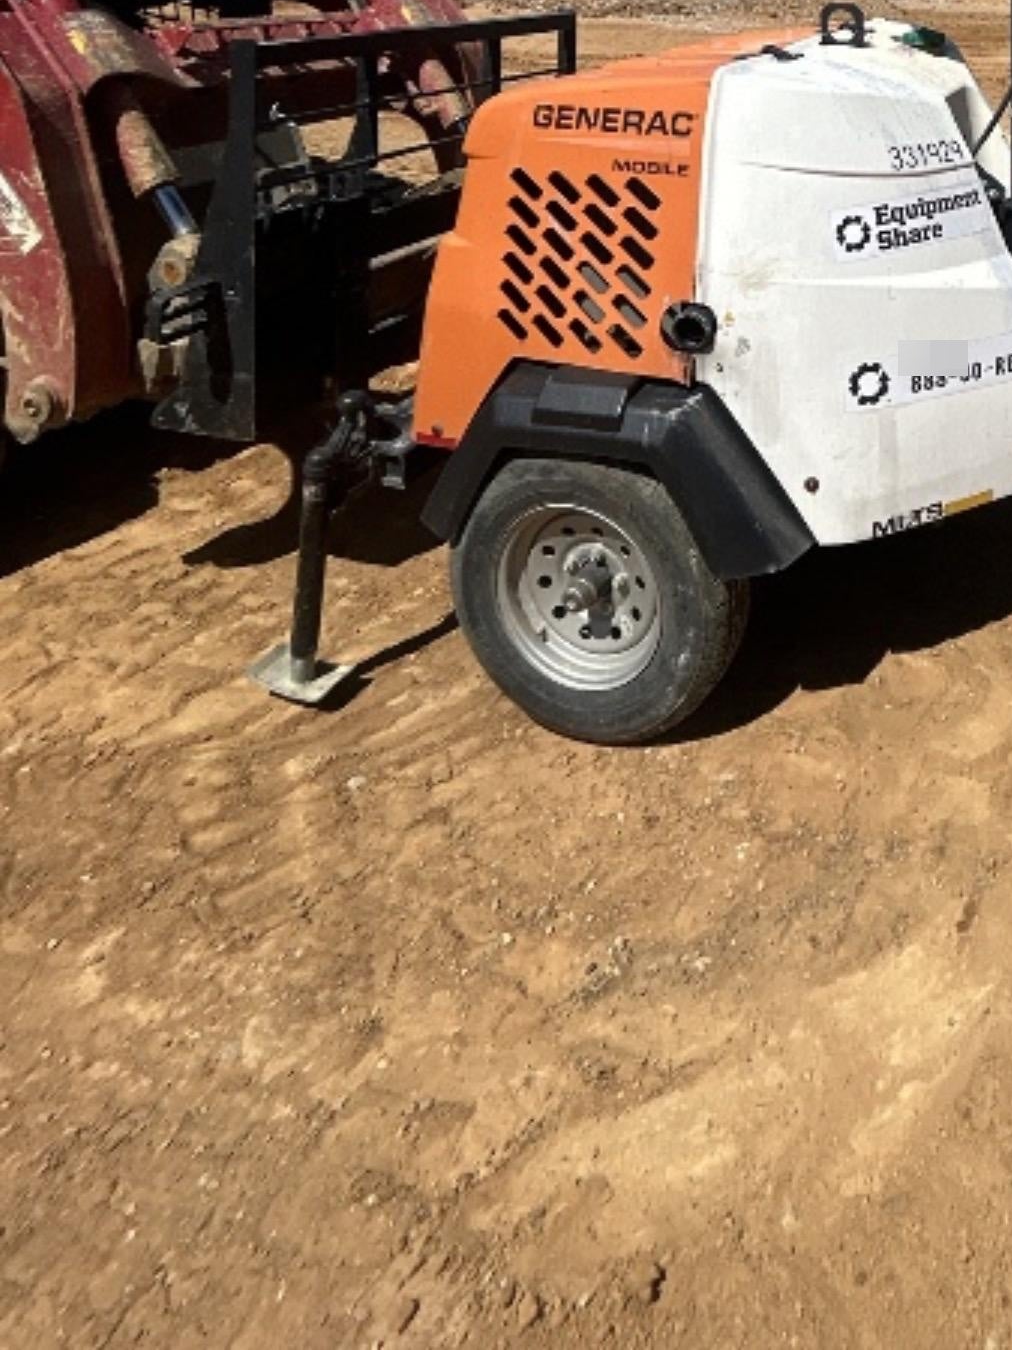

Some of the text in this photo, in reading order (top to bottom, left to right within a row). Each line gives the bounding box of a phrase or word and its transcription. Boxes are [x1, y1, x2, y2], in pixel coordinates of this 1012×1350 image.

[533, 104, 694, 136] GENERAC
[611, 158, 690, 177] MOBILE
[872, 188, 982, 226] Equipment
[876, 222, 943, 250] Share
